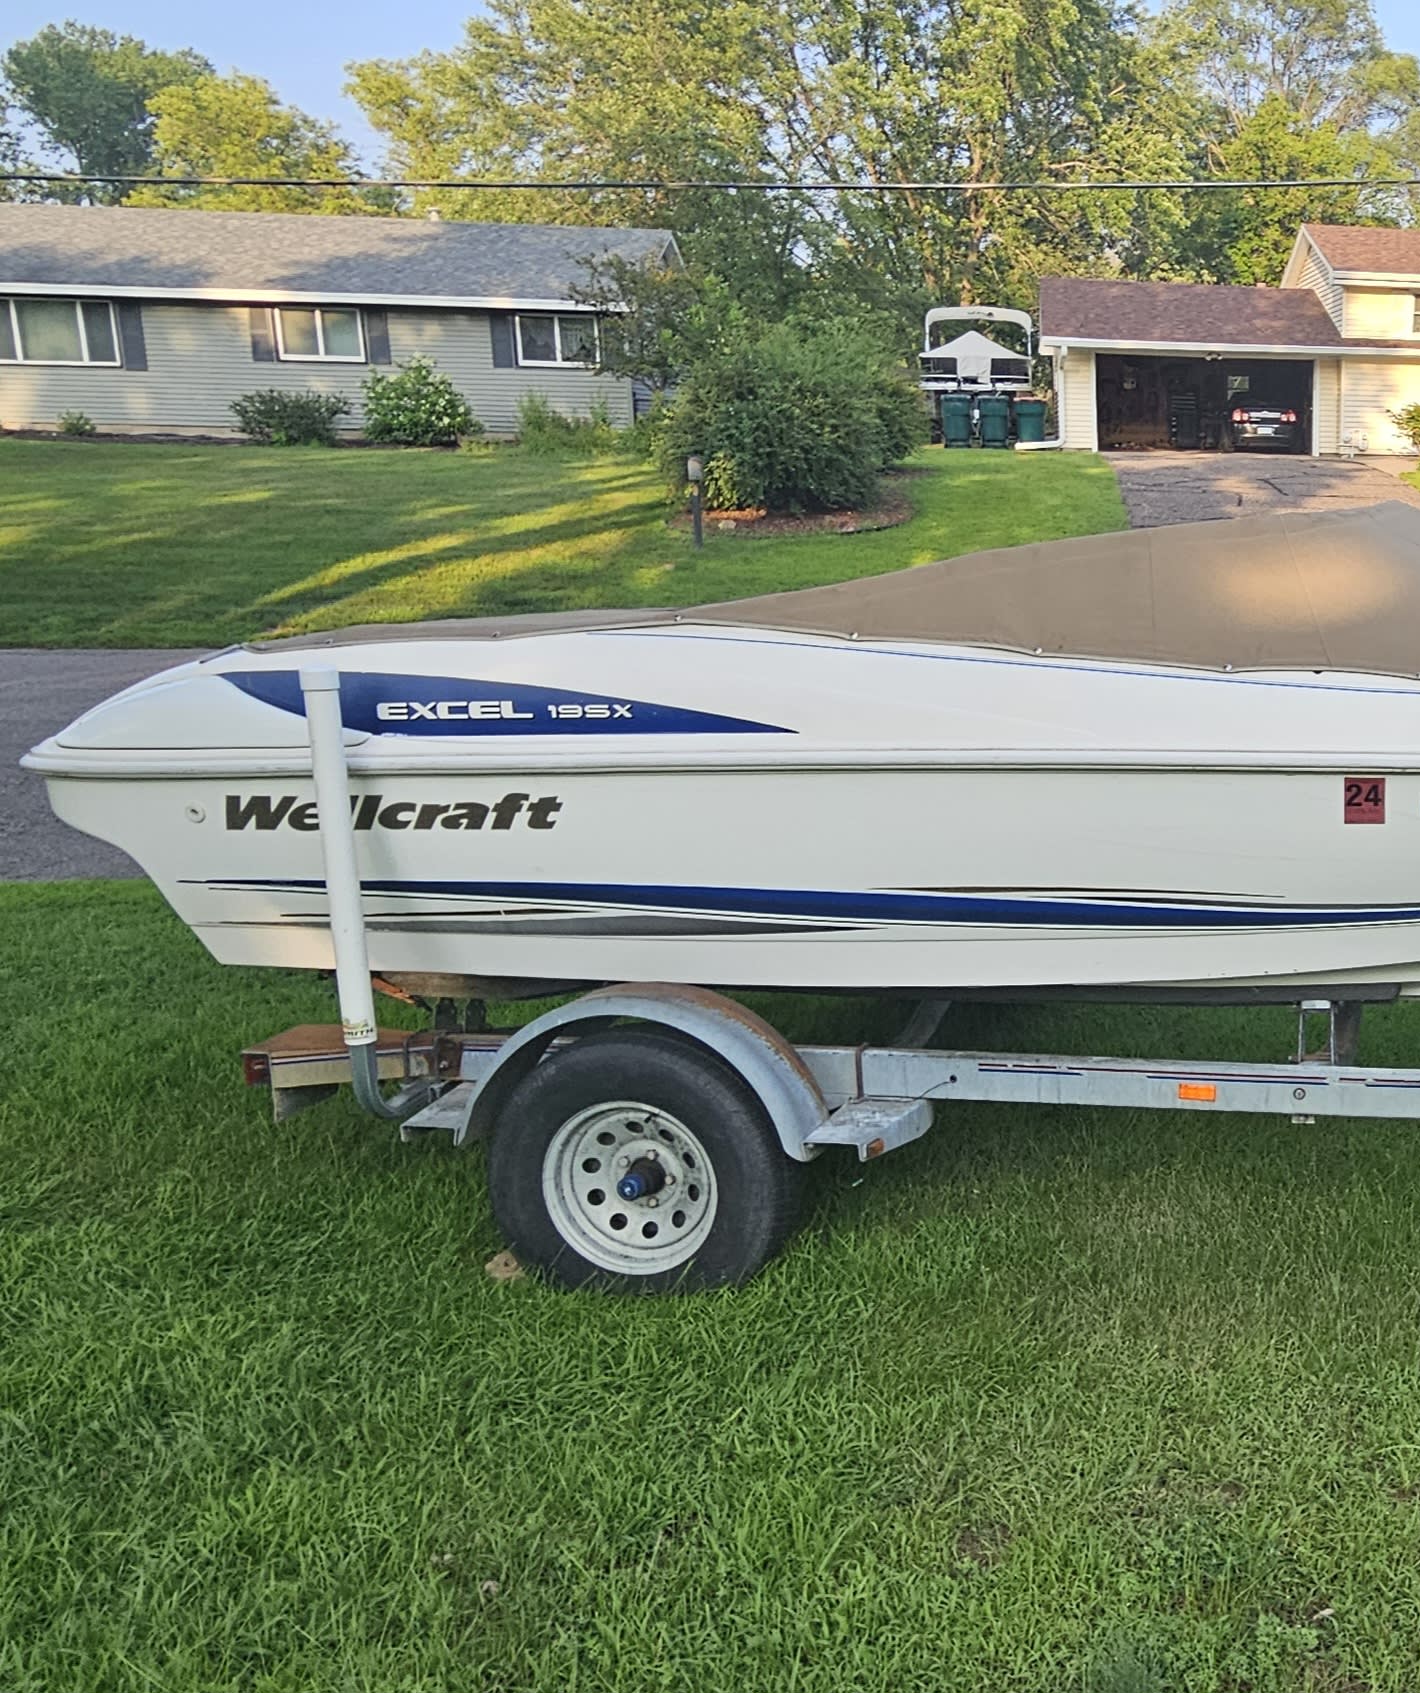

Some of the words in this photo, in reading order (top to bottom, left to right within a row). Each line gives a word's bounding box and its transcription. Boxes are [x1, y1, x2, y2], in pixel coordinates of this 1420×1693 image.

[376, 700, 534, 721] EXCEL
[547, 703, 633, 719] 19SX
[1345, 784, 1382, 807] 24
[225, 792, 564, 831] Welcraft
